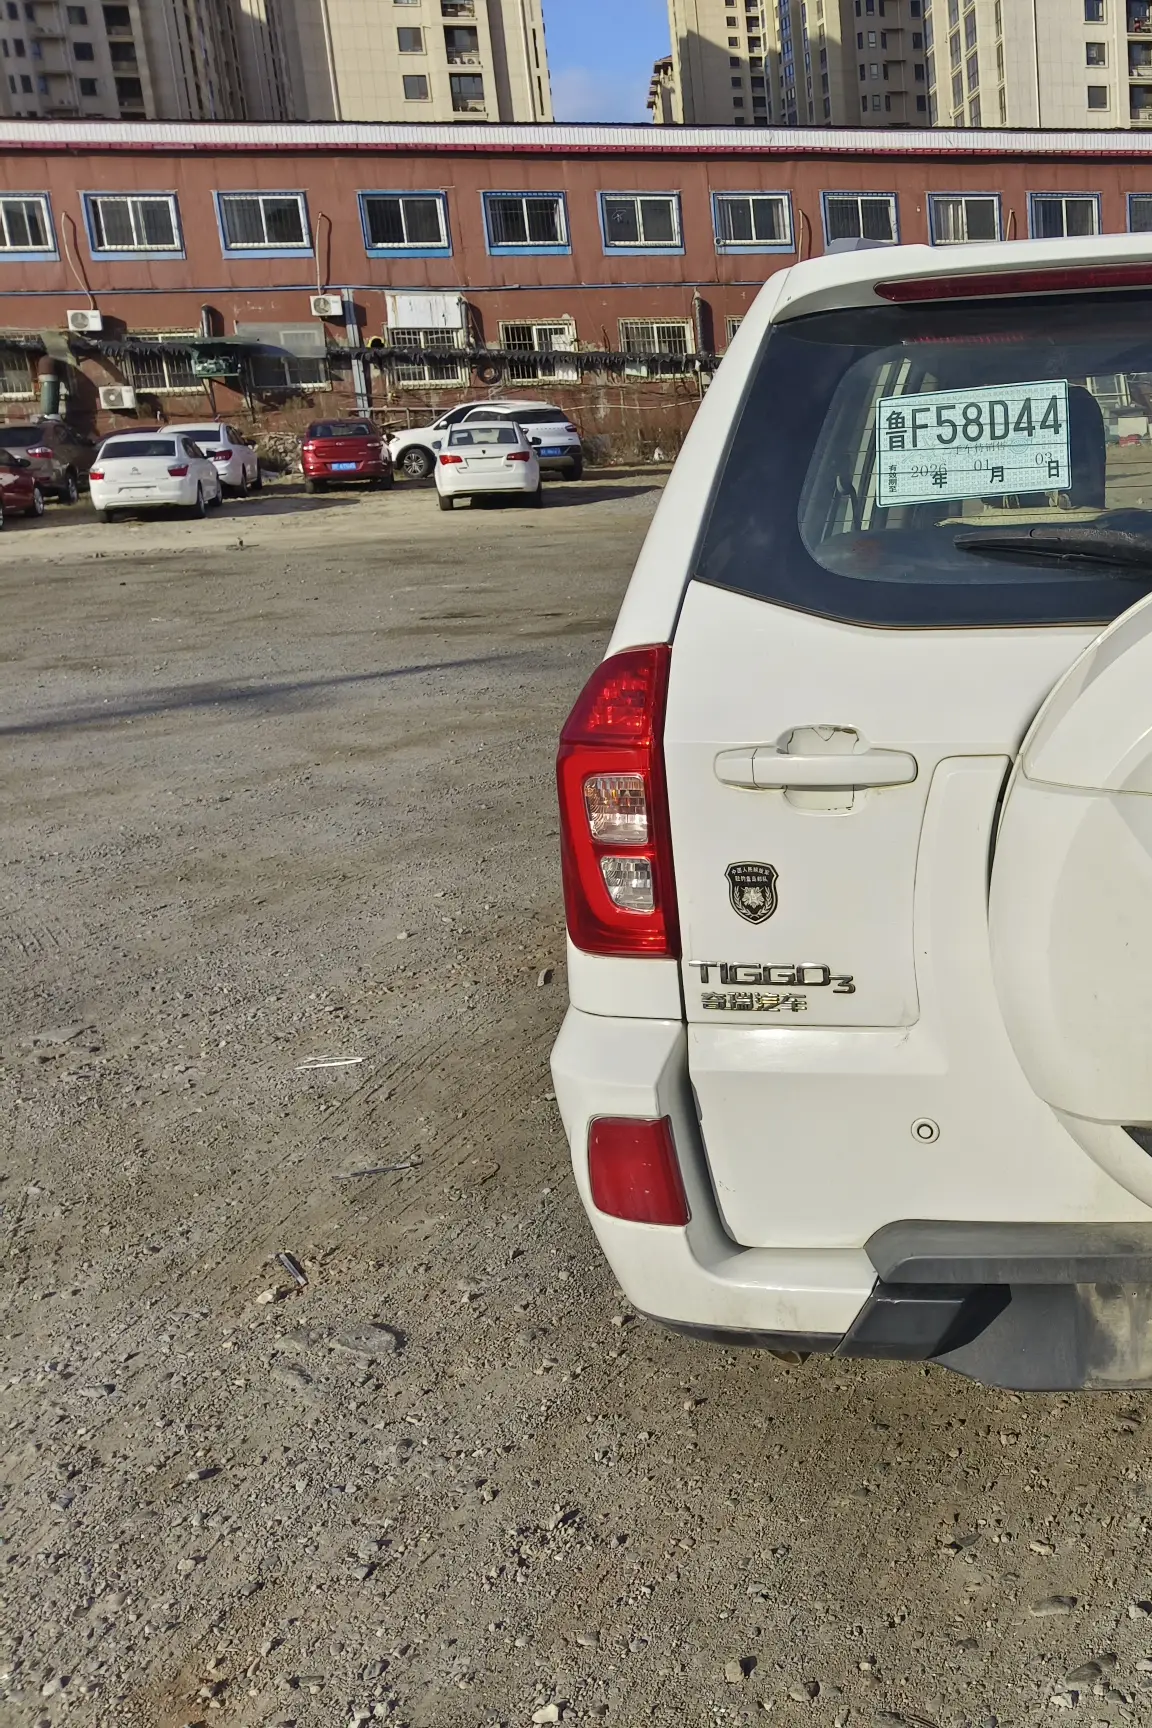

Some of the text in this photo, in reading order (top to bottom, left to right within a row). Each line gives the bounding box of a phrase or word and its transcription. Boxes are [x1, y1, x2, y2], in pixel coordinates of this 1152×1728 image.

[886, 394, 1063, 451] 鲁F58D44
[888, 464, 898, 492] 有效期至
[932, 472, 948, 488] 年
[990, 466, 1004, 484] 月
[1048, 460, 1060, 478] 日
[700, 991, 808, 1013] 奇瑞汽车
